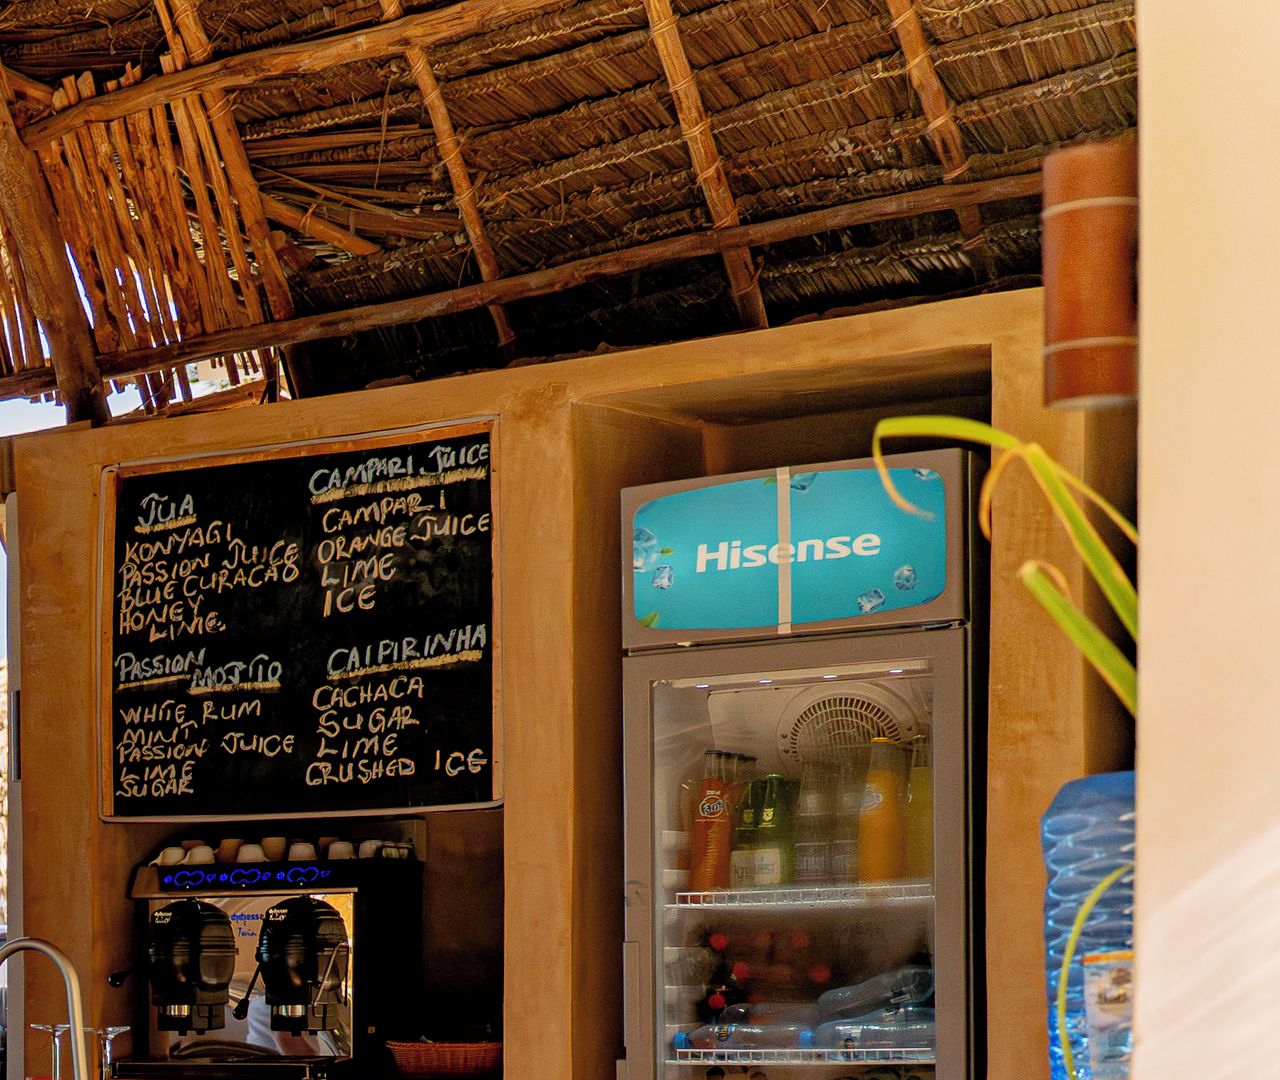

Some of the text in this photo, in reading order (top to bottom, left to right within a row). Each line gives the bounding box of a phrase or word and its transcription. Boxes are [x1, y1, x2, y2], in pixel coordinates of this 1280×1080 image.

[308, 443, 489, 495] CAMPARI JUICE
[138, 493, 193, 527] JUA
[125, 520, 232, 564] KONYAGI
[317, 513, 489, 564] ORANGE JUICE
[696, 533, 881, 573] Hisense
[119, 538, 298, 590] PASSION JUICE
[321, 553, 396, 588] LIME
[117, 564, 299, 611] BLUE CURACAO
[323, 584, 376, 618] ICE
[119, 594, 204, 635] HONEY
[114, 647, 283, 687] PASSION MOJITO
[327, 624, 487, 675] CAIPIRINHA
[312, 676, 424, 711] CACHACA
[119, 699, 261, 725] WHITE RUM
[316, 705, 420, 738] SUGAR
[116, 732, 295, 764] PASSION JUICE
[123, 720, 198, 747] MINT
[317, 733, 398, 759] LIME
[120, 761, 195, 781] LIME
[306, 748, 487, 786] CRUSHED ICE
[116, 779, 194, 797] SUGAR
